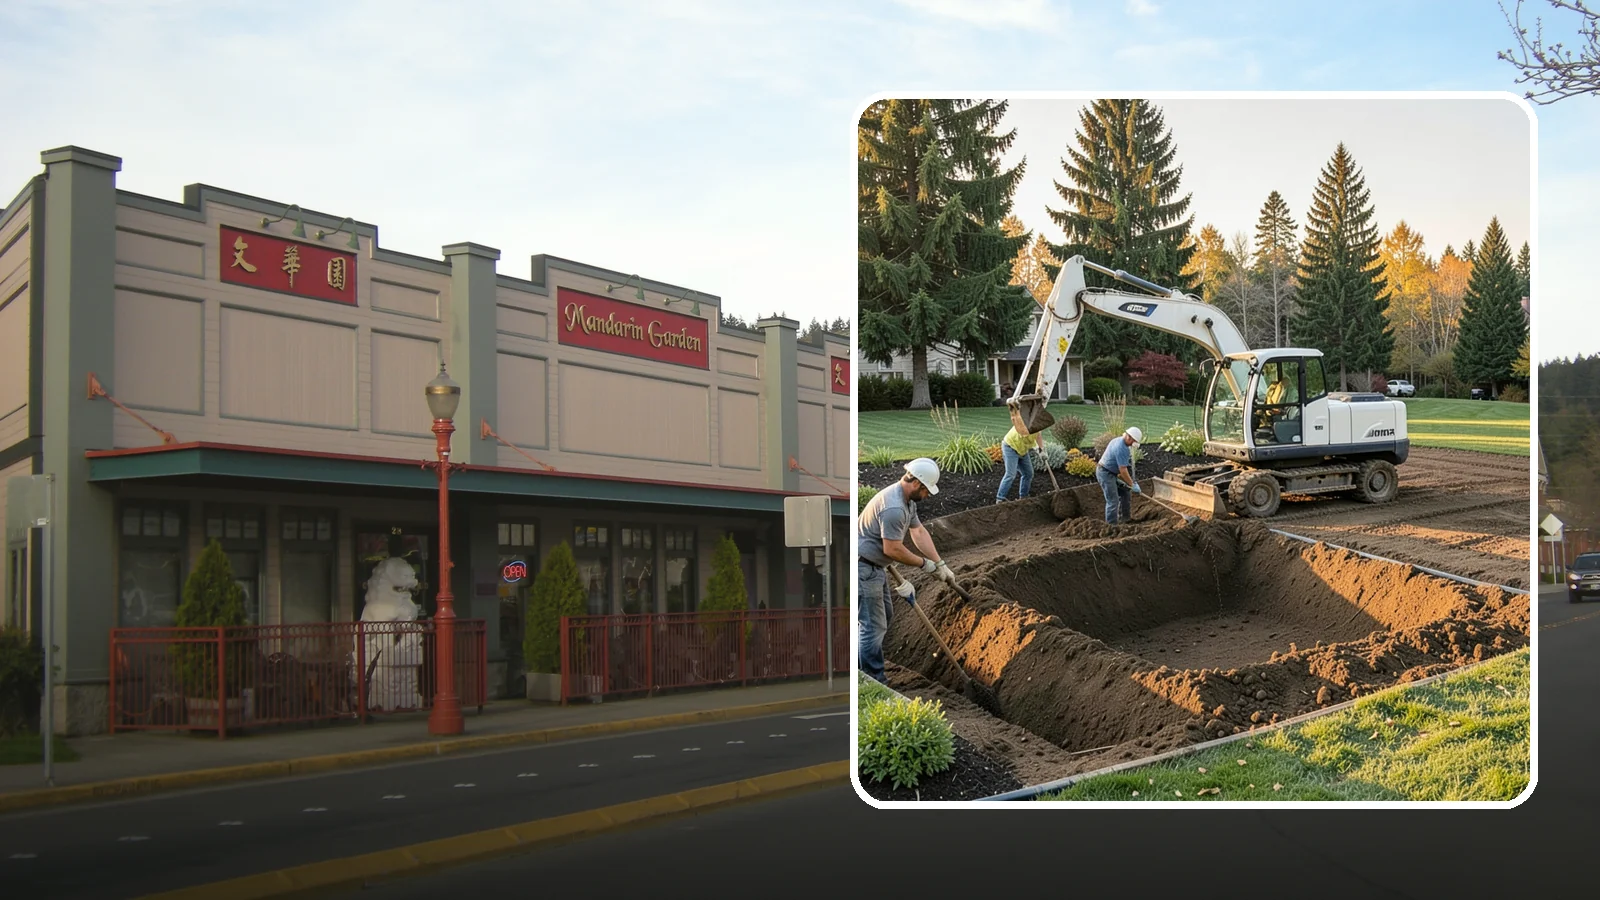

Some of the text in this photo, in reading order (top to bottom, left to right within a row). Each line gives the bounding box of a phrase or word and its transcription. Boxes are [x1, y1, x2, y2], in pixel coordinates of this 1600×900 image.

[230, 235, 346, 291] 文華園
[564, 302, 702, 352] Mandarin Garden
[503, 565, 527, 578] OPEN
